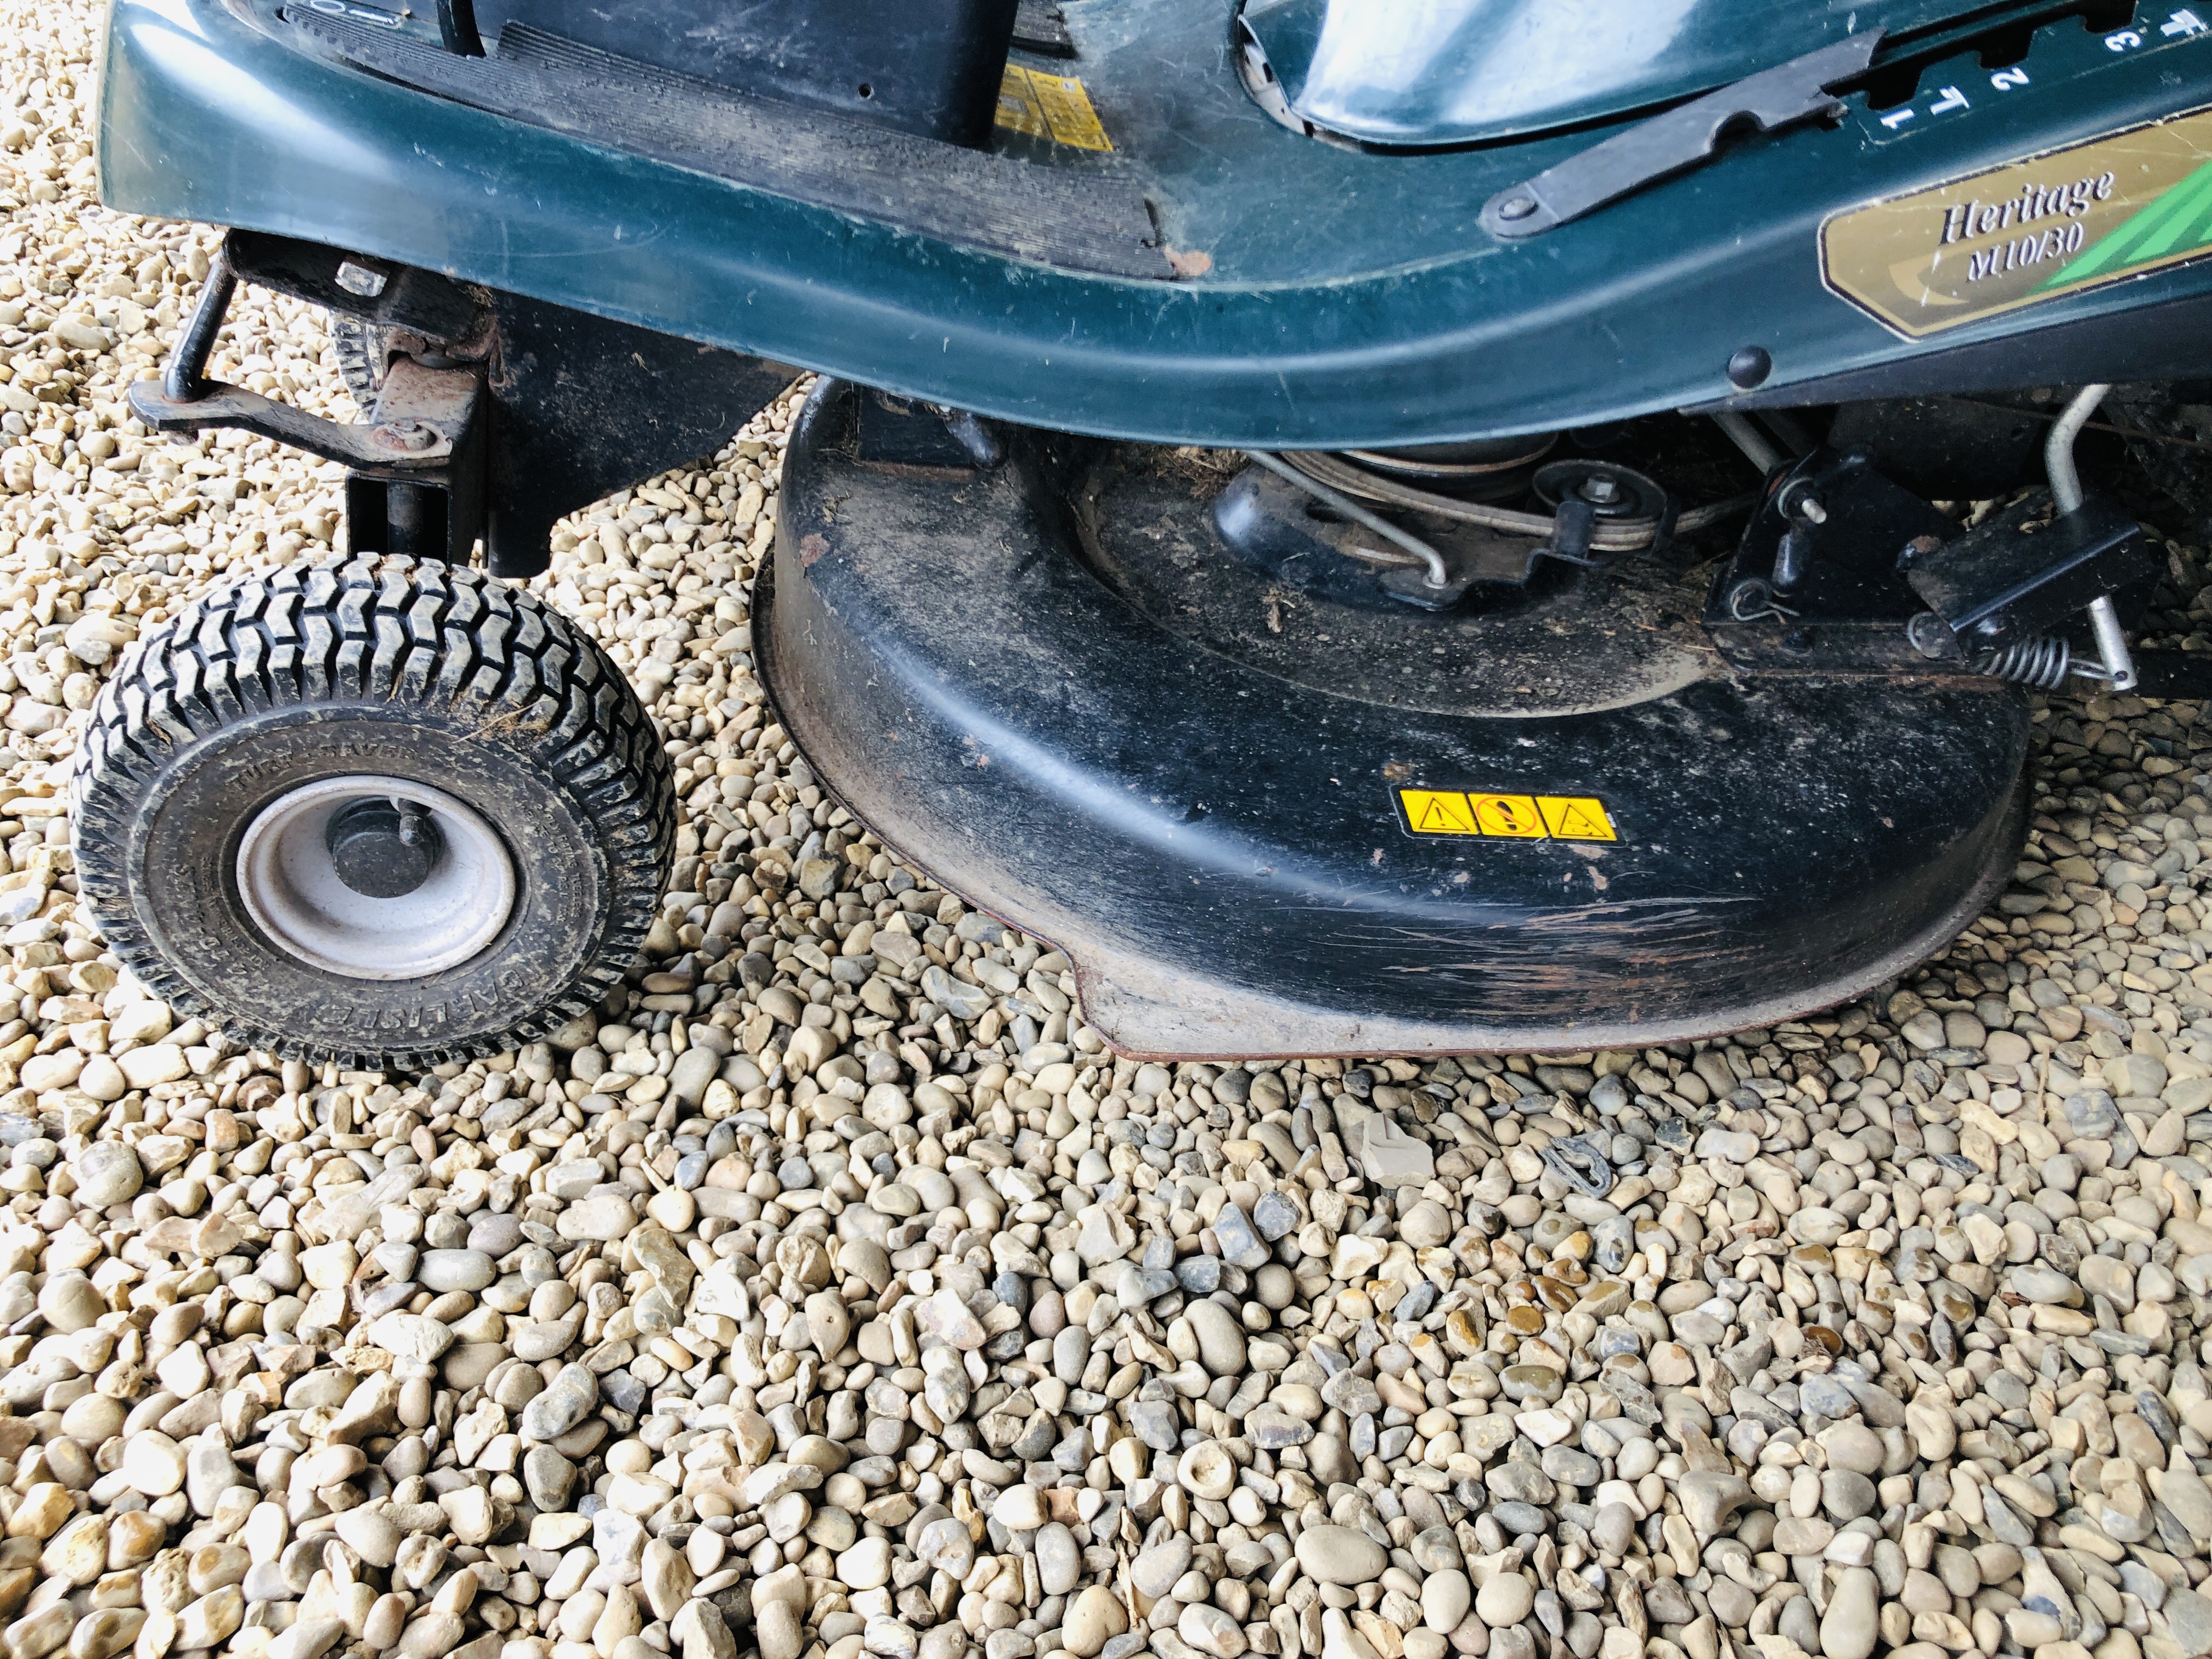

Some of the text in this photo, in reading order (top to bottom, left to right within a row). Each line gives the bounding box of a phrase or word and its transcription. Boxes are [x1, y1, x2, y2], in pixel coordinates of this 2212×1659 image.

[2104, 31, 2141, 52] 3
[1991, 66, 2029, 91] 2
[1880, 109, 1915, 129] 1
[1940, 171, 2115, 245] Heritage
[1967, 221, 2084, 283] M10/30
